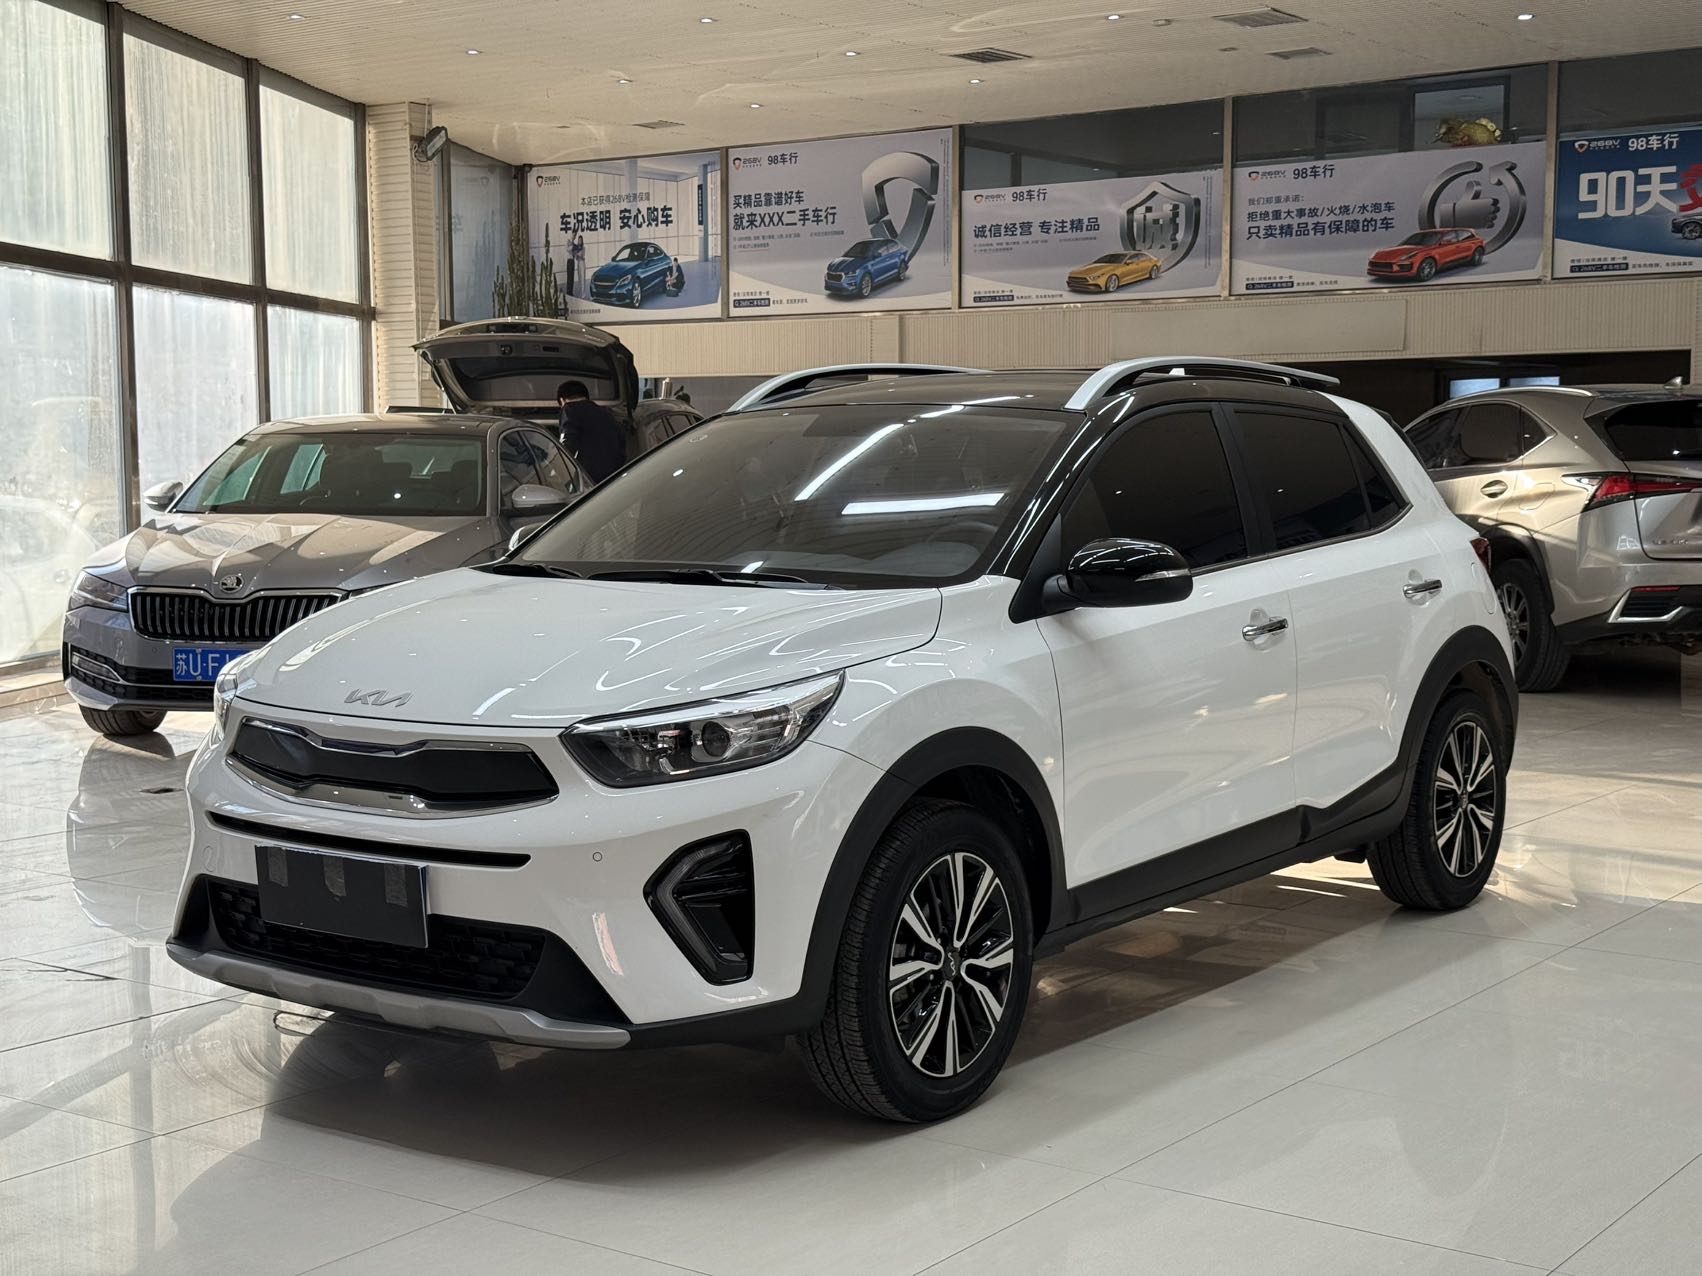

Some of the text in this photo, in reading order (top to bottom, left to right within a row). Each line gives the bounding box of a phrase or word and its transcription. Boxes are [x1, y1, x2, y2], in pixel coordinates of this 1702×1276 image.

[1628, 133, 1680, 151] 98车行
[768, 152, 799, 166] 98车行
[1293, 164, 1335, 180] 98车行
[733, 189, 805, 210] 买精品靠谱好车
[1012, 188, 1048, 202] 98车行
[560, 210, 611, 234] 车况透明
[619, 205, 674, 230] 安心购车
[733, 207, 837, 230] 就来XXX二手车行
[1247, 201, 1395, 223] 拒绝重大事故/火烧/水泡车
[974, 216, 1101, 239] 诚信经营 专注精品
[1247, 216, 1395, 241] 只卖精品有保障的车
[344, 688, 413, 708] KIA
